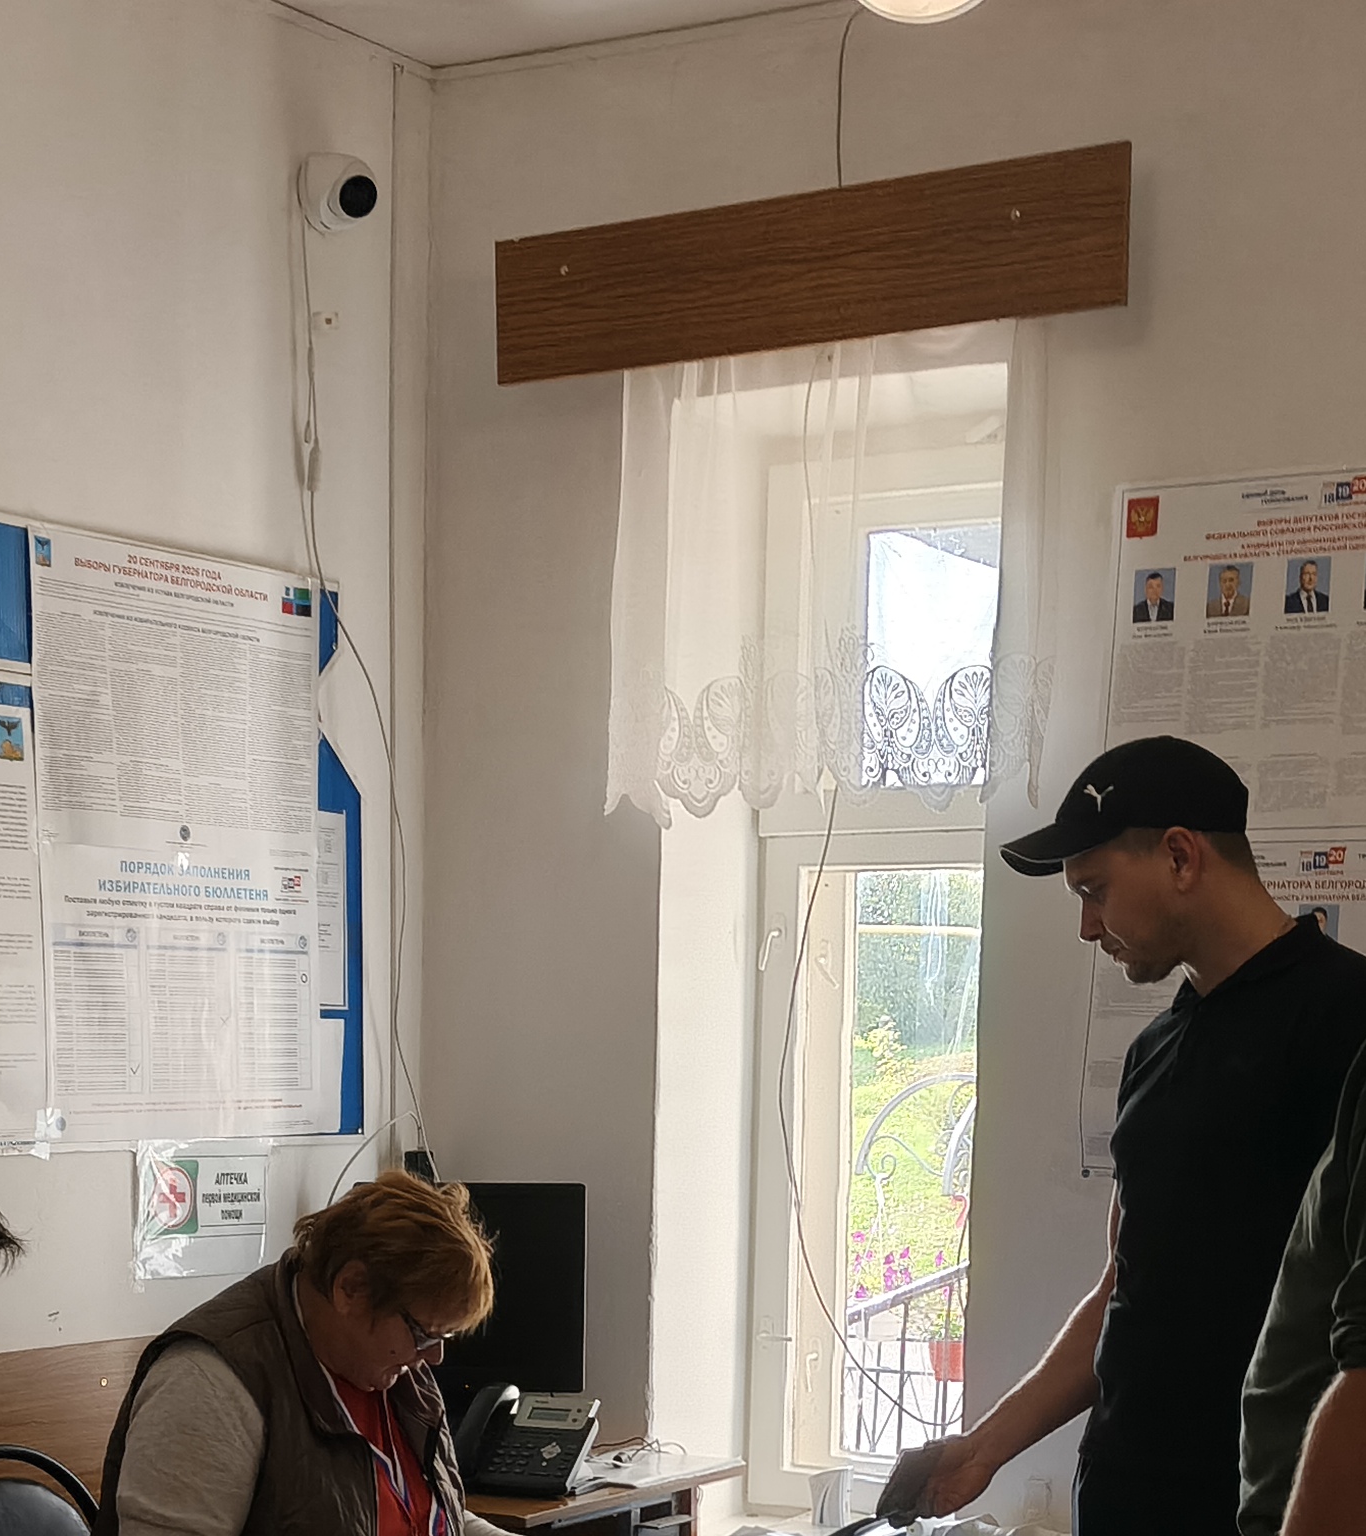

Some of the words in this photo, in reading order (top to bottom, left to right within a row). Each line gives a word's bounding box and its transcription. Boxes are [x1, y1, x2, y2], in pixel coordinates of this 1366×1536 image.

[1352, 479, 1366, 492] 20
[1293, 513, 1340, 525] ДЕПУТАТОВ
[127, 554, 137, 564] 20
[138, 556, 180, 572] СЕНТЯБРЯ
[201, 568, 222, 581] ГОДА
[74, 557, 111, 573] ВЫБОРЫ
[112, 564, 169, 584] ГУБЕРНАТОРА
[170, 575, 233, 595] БЕЛГОРОДСКОЙ
[234, 587, 269, 602] ОБЛАСТИ
[1328, 849, 1344, 861] 20
[119, 860, 175, 877] ПОРЯДОК
[178, 864, 251, 881] ЗАПОЛНЕНИЯ
[98, 879, 201, 897] ИЗБИРАТЕЛЬНОГО
[204, 886, 269, 902] БЮЛЛЕТЕНЯ
[1263, 880, 1312, 890] РНАТОРА
[214, 1172, 248, 1185] АПТЕЧКА
[222, 1188, 261, 1205] медицинской
